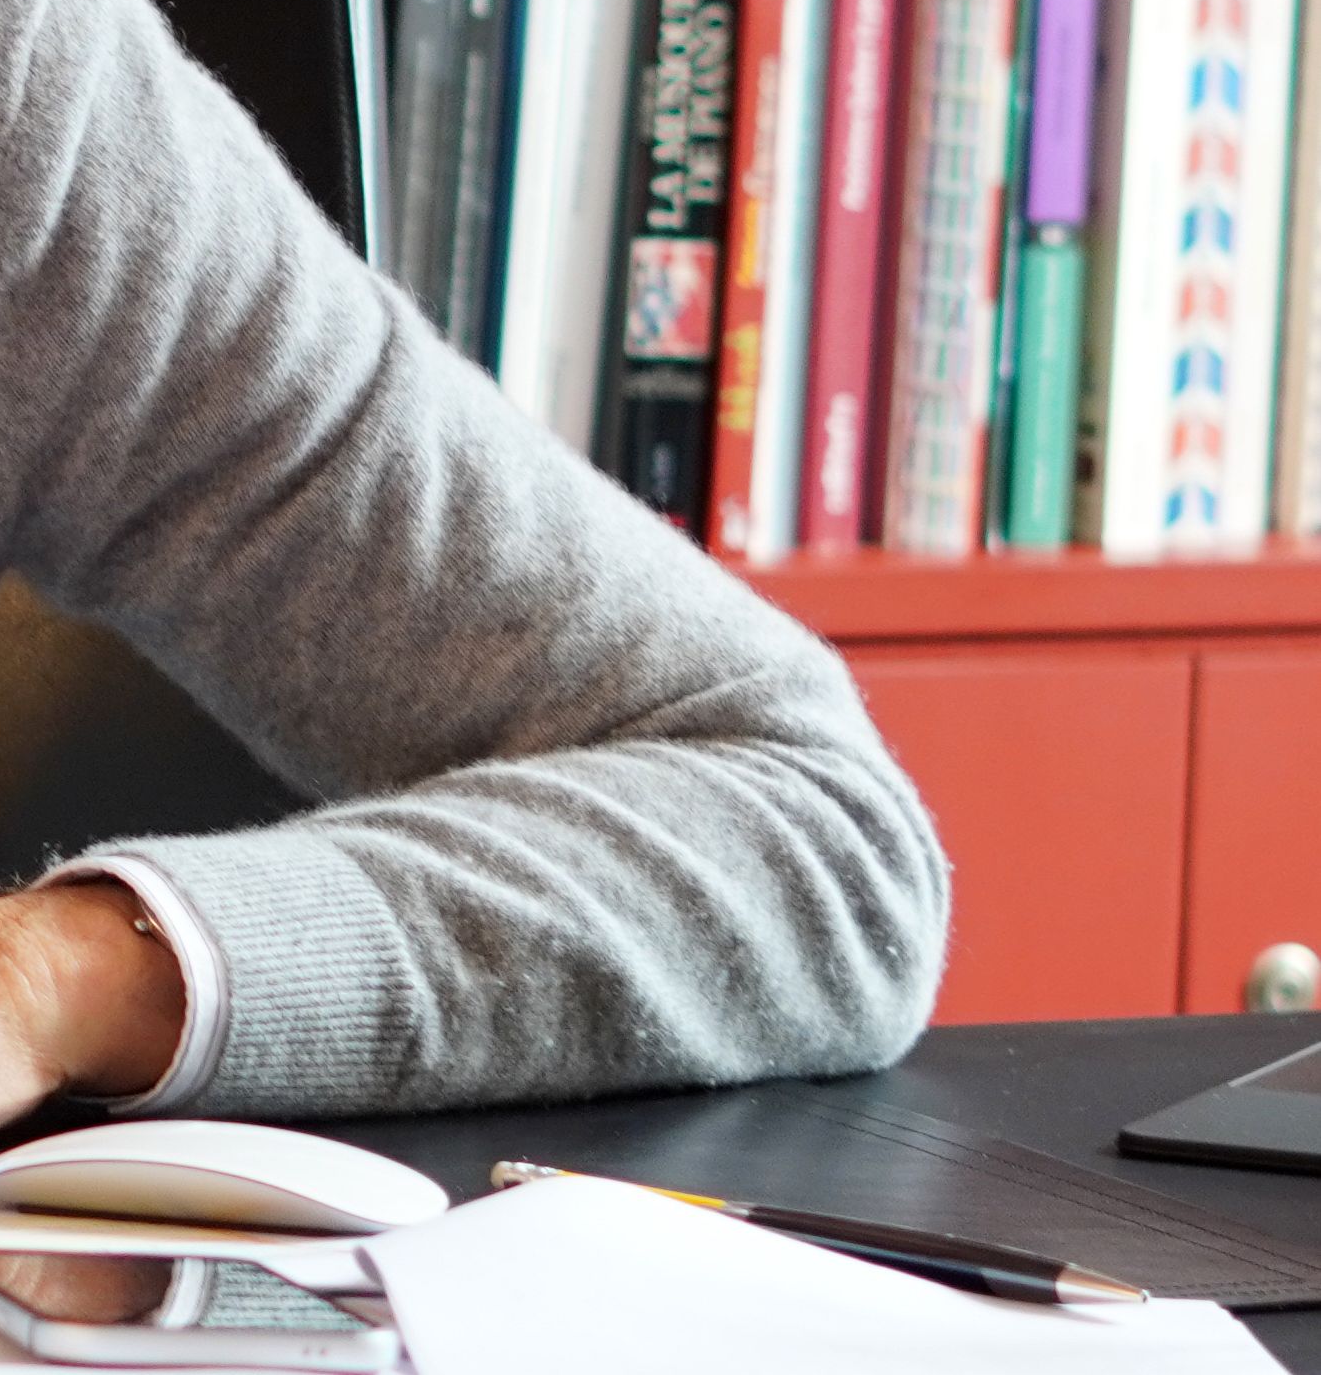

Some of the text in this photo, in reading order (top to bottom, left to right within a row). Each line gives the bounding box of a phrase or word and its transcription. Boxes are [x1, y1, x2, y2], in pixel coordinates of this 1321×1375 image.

[688, 1, 735, 203] DE PIANO
[646, 171, 690, 229] LA
